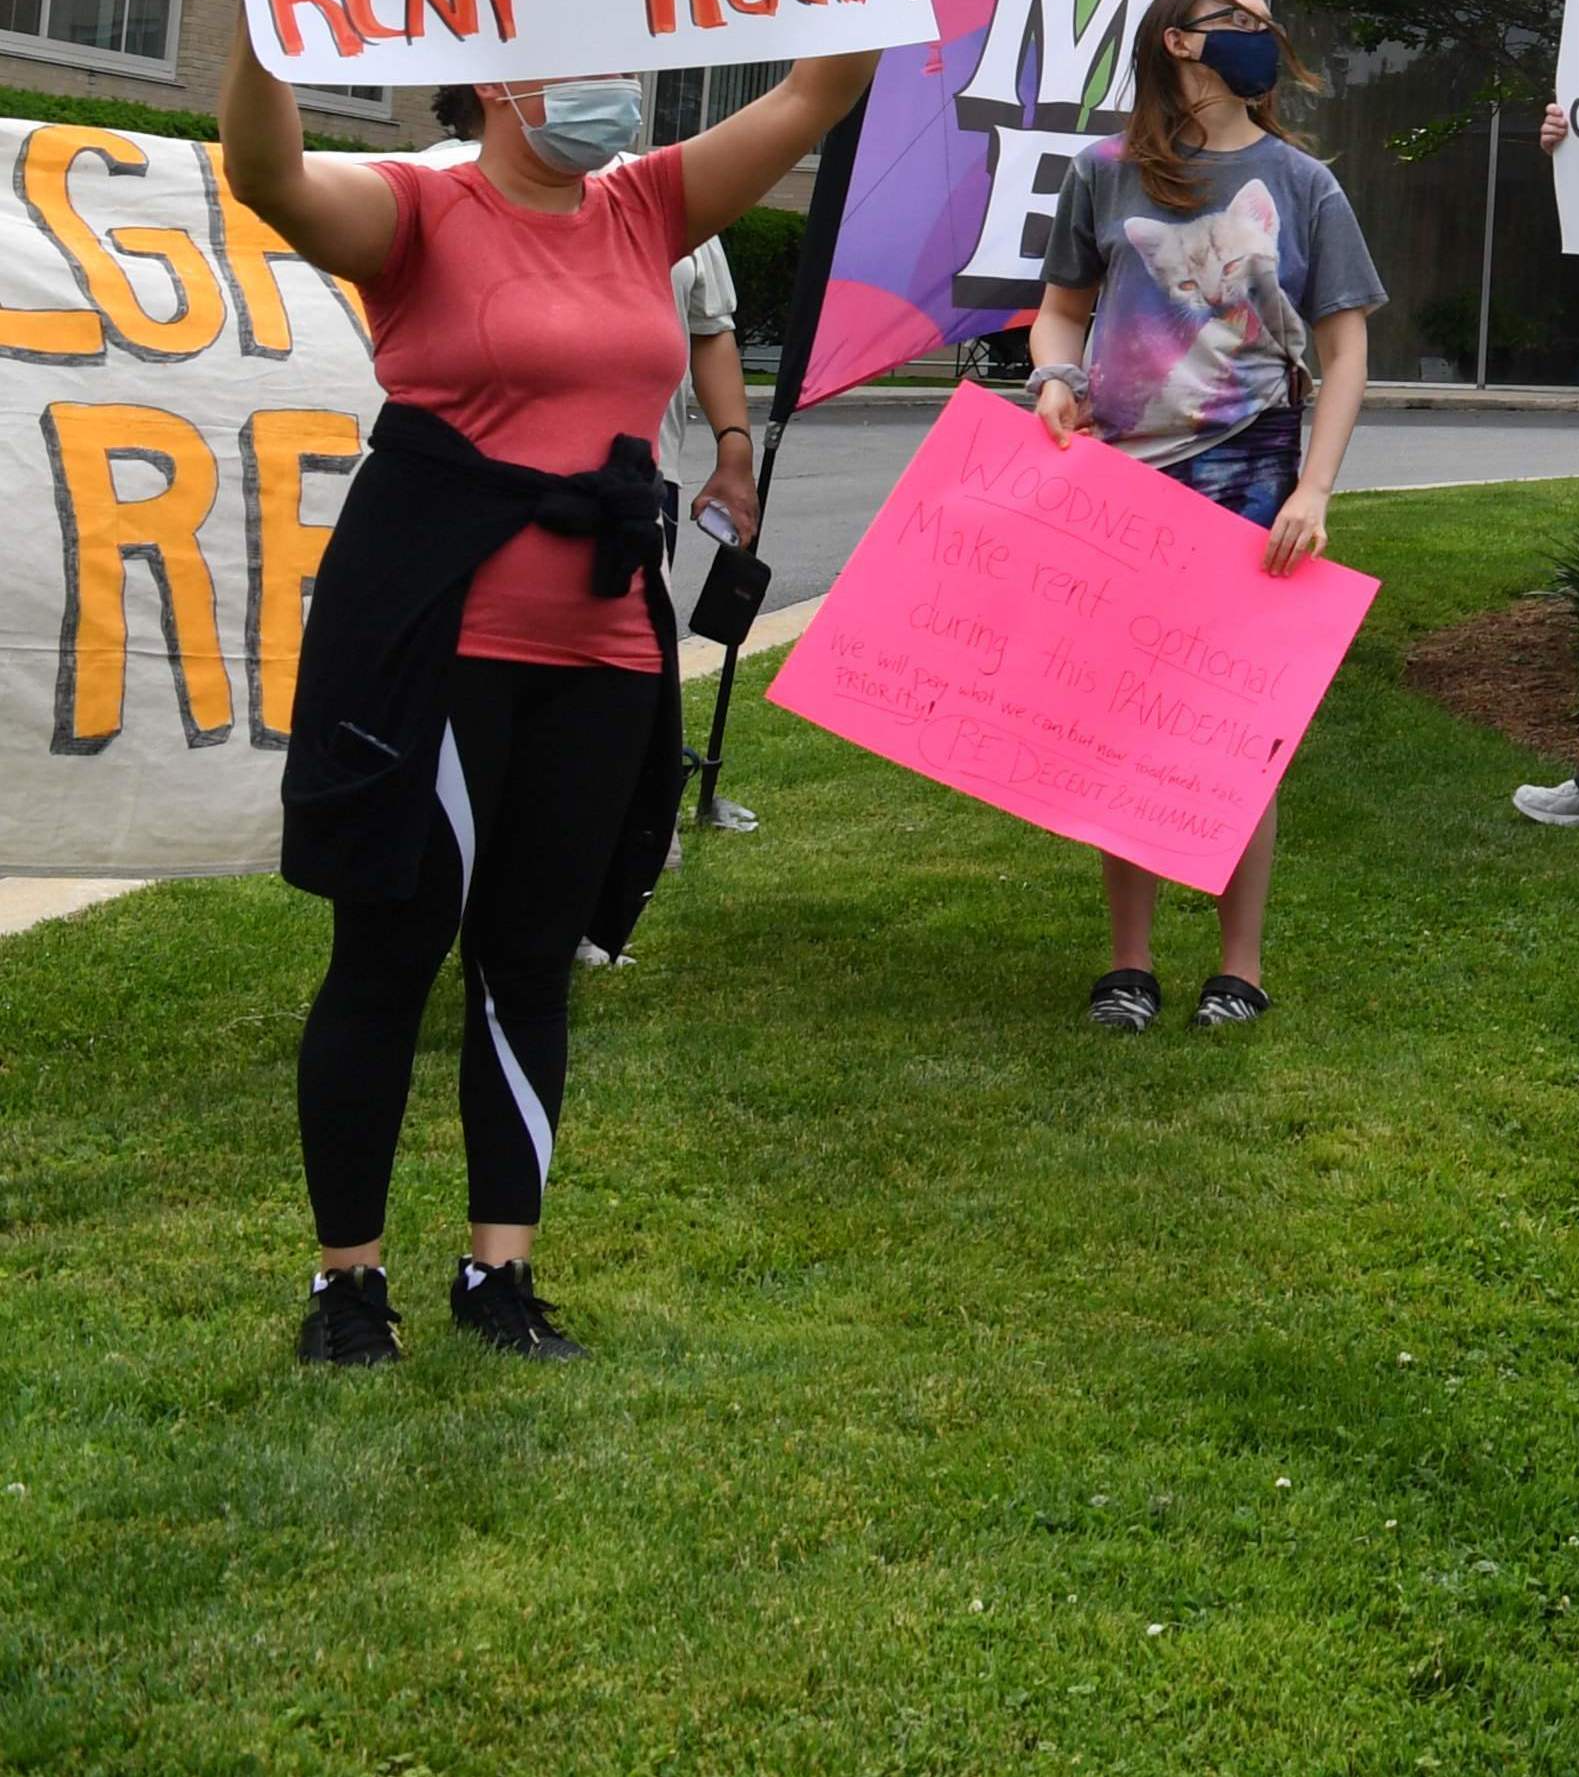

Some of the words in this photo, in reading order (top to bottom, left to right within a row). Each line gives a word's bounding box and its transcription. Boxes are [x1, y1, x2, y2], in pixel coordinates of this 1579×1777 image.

[960, 417, 1197, 571] WOODNER:
[898, 500, 1010, 580] Make
[1031, 563, 1113, 619] rent
[909, 580, 1008, 676] during
[1041, 636, 1097, 694] this
